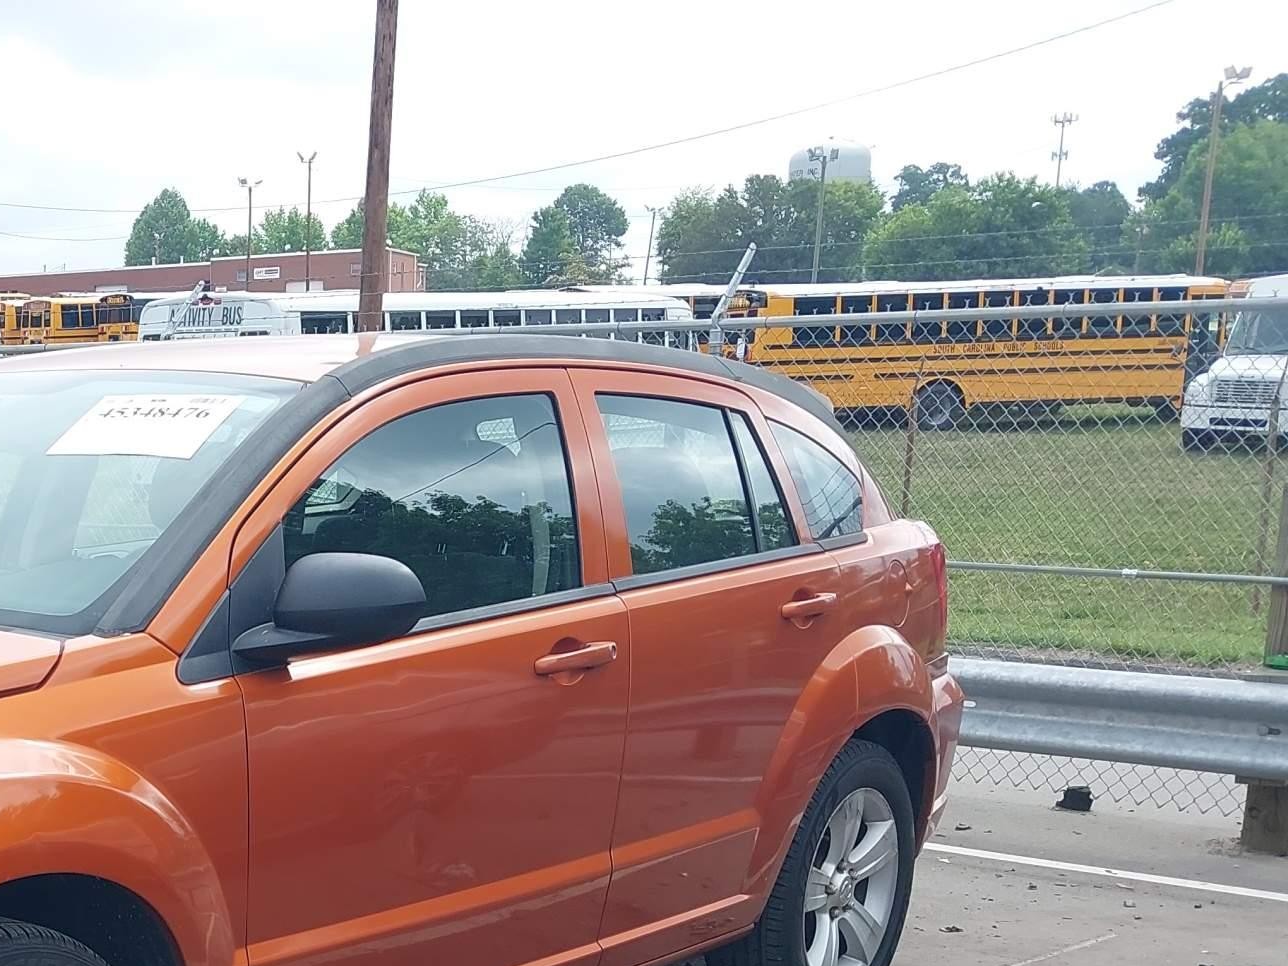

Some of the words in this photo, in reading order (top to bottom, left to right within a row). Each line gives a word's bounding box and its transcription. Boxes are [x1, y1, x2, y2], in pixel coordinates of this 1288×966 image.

[222, 306, 243, 326] BUS
[933, 344, 955, 354] SOUTH
[963, 343, 996, 353] CAROLINA
[99, 407, 210, 418] 45348476
